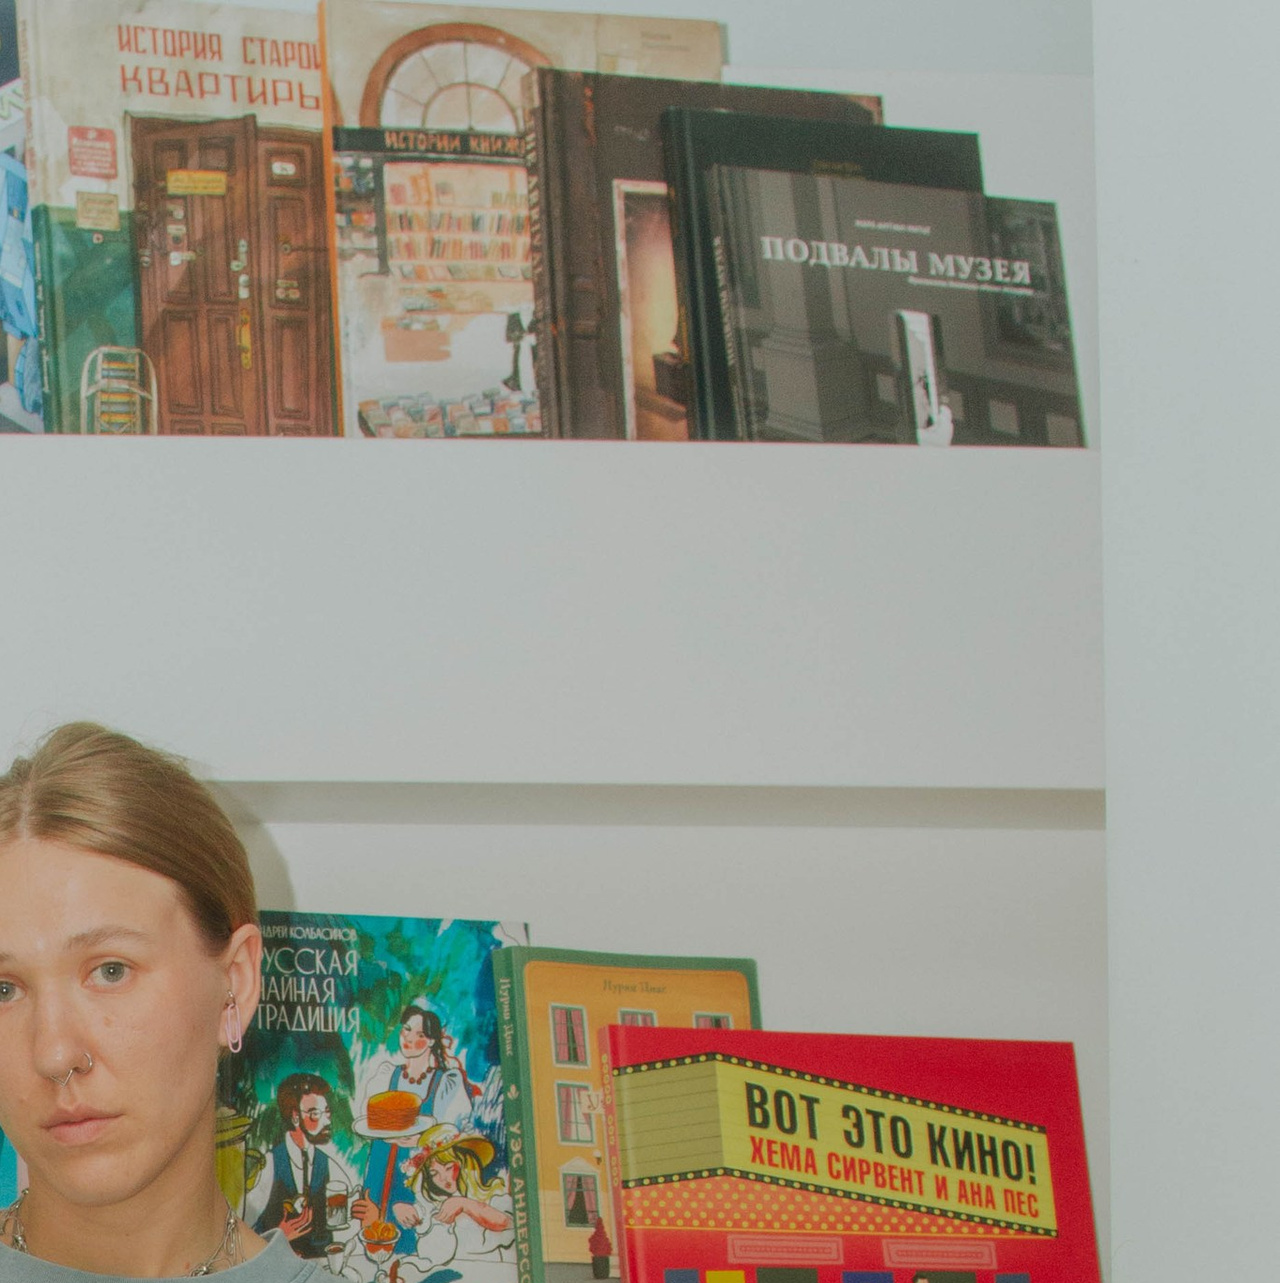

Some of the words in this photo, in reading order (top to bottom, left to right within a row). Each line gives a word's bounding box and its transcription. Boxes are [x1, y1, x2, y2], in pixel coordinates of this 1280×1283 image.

[117, 24, 223, 62] ИСТОРИЯ
[385, 130, 461, 151] ИСТОРИИ
[761, 236, 919, 273] ПОДВАЛЫ
[928, 251, 1031, 284] МУЗЕЯ
[261, 926, 288, 938] НДРЕЙ
[289, 926, 358, 940] КОЛБАСИНОВ
[262, 947, 358, 976] УССКАЯ
[258, 1004, 360, 1033] ТРАДИЦИЯ
[508, 1121, 524, 1168] УЭС
[745, 1080, 820, 1141] ВОТ
[842, 1103, 914, 1159] ЭТО
[926, 1122, 1037, 1185] КИНО!
[750, 1135, 818, 1176] ХЕМА
[827, 1151, 925, 1197] СИРВЕНТ
[935, 1174, 949, 1202] И
[958, 1179, 996, 1211] АНА
[1004, 1188, 1040, 1219] ПЕС
